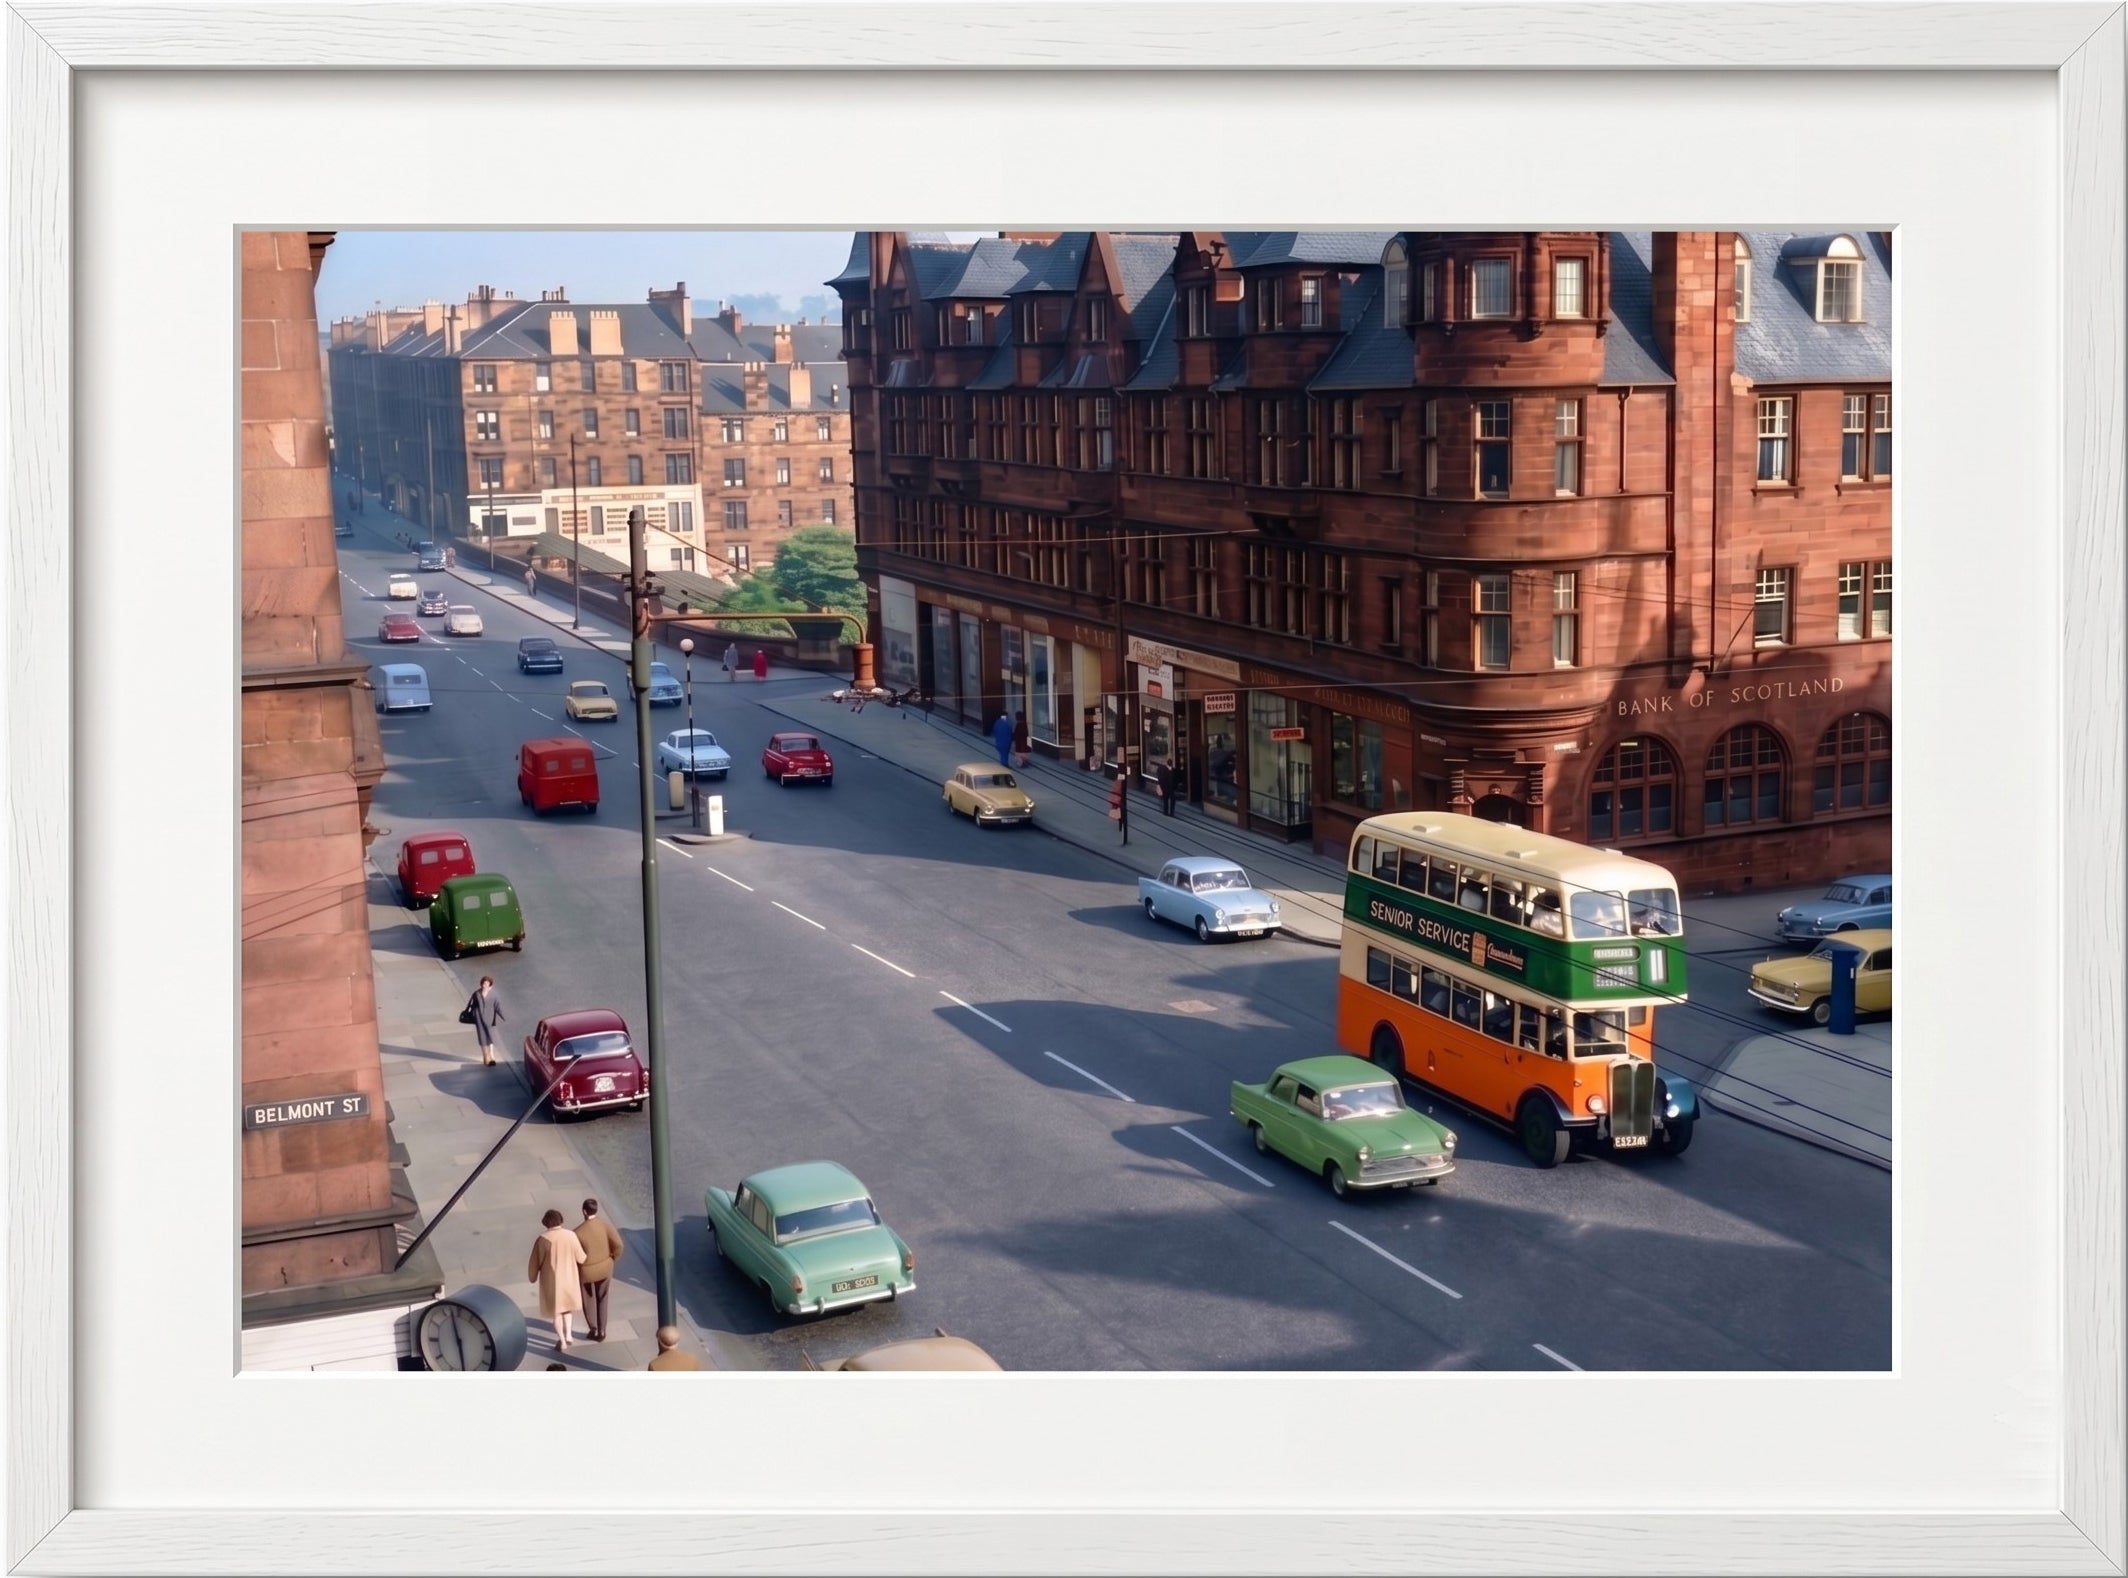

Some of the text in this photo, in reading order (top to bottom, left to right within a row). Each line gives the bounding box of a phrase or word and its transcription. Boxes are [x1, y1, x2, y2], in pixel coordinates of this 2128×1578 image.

[1618, 677, 1844, 716] BANK OF SCOTLAND
[1370, 900, 1414, 931] SENIOR
[1417, 917, 1471, 953] SERVICE
[255, 1097, 361, 1124] BELMONT ST
